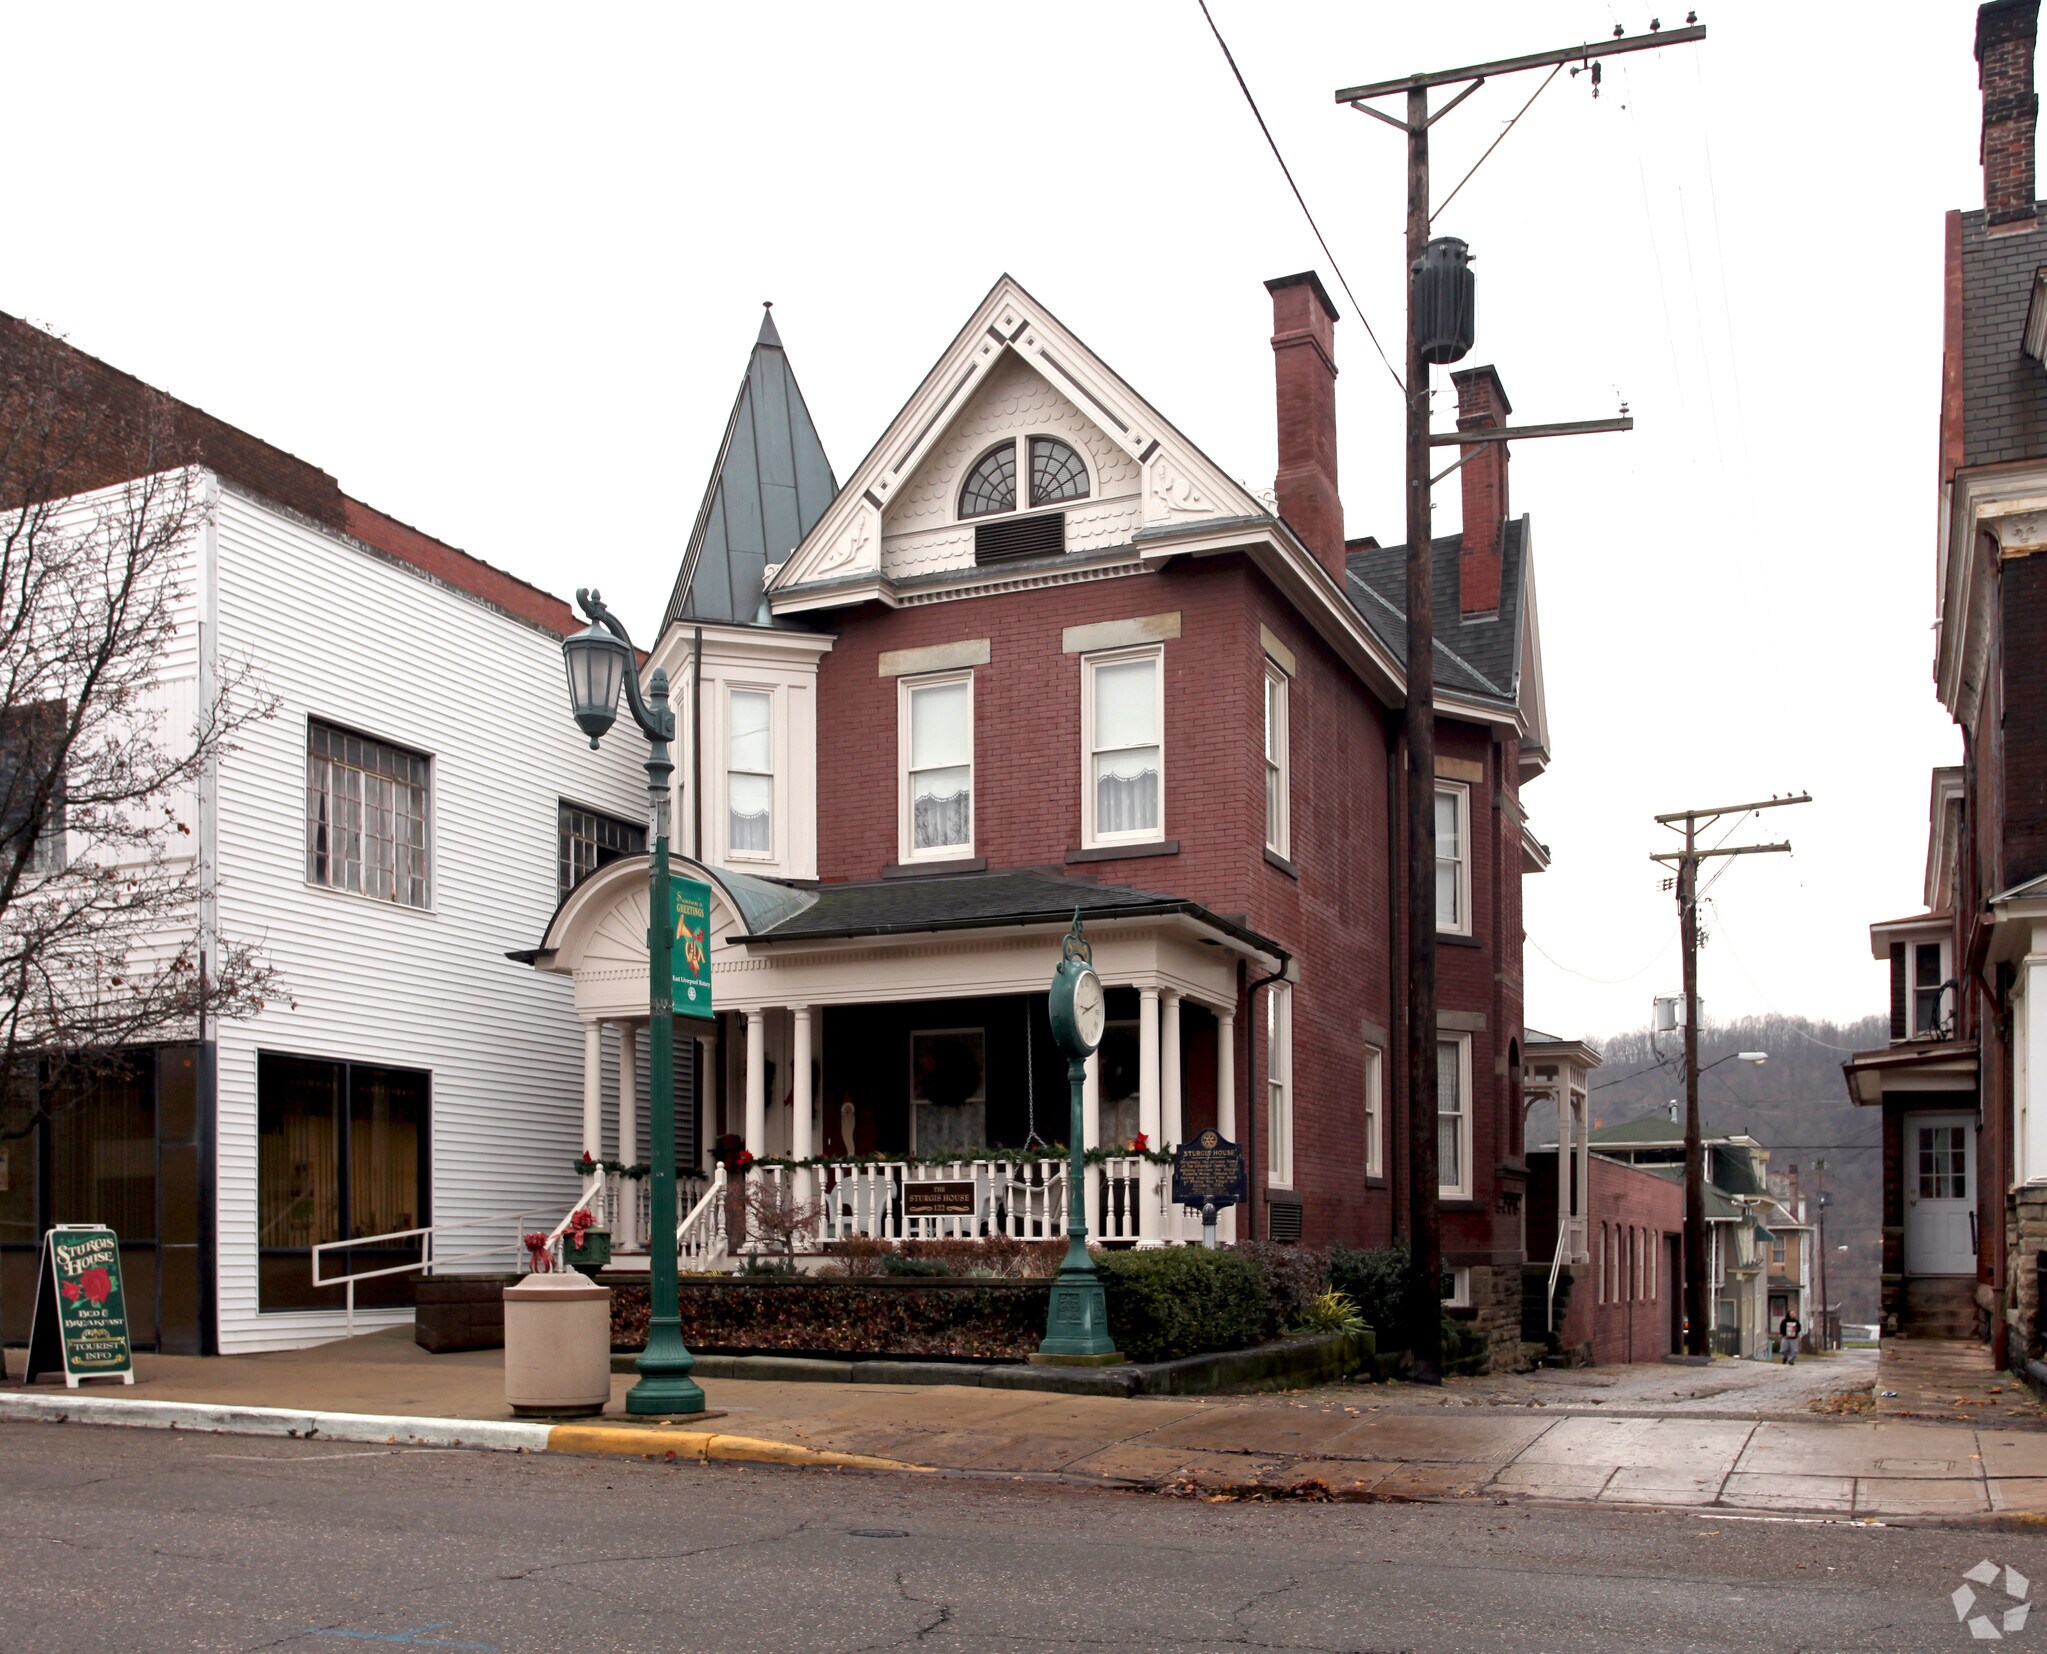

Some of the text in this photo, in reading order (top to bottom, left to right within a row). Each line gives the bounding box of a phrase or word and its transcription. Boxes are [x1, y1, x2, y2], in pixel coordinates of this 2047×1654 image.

[676, 903, 704, 918] GREETINGS
[681, 976, 698, 986] Liverpool
[698, 980, 711, 988] Rotary
[909, 1193, 970, 1203] STURGIS HOUSE
[933, 1204, 946, 1212] 122
[56, 1237, 115, 1265] STURGIS
[64, 1251, 115, 1276] HOUSE
[101, 1308, 109, 1318] &
[65, 1318, 125, 1328] BREAKFAST
[74, 1342, 119, 1351] TOURIST
[85, 1351, 112, 1360] INFO
